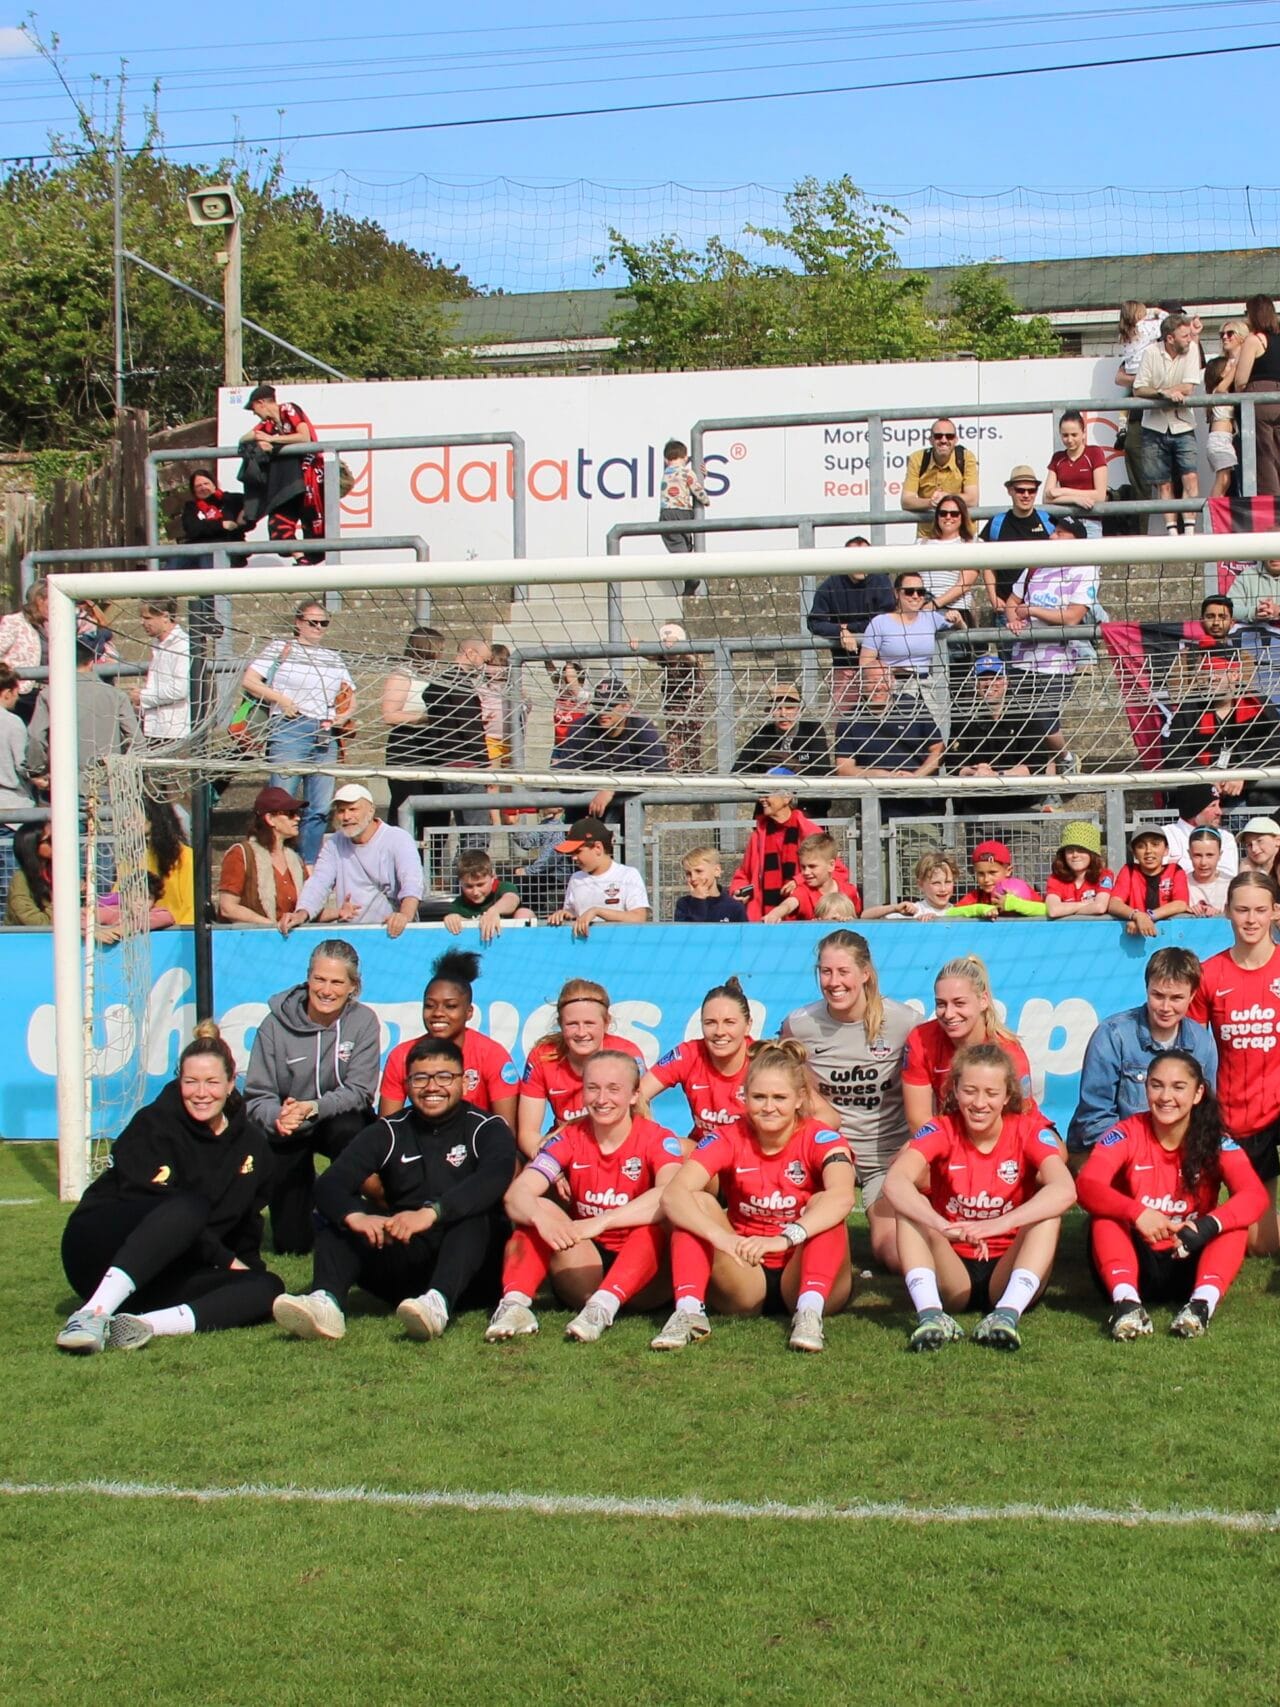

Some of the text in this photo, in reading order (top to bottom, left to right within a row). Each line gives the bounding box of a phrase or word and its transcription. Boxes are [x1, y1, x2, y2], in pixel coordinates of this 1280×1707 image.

[882, 423, 1003, 446] Suppters.
[824, 480, 869, 497] Real
[1230, 1003, 1276, 1022] who
[1220, 1022, 1273, 1041] gives
[1232, 1035, 1277, 1053] crap
[830, 1065, 879, 1082] who
[880, 1079, 892, 1092] a
[832, 1095, 881, 1110] crap
[585, 1188, 629, 1206] who
[749, 1190, 797, 1210] who
[957, 1190, 1004, 1209] who
[1141, 1194, 1188, 1213] who
